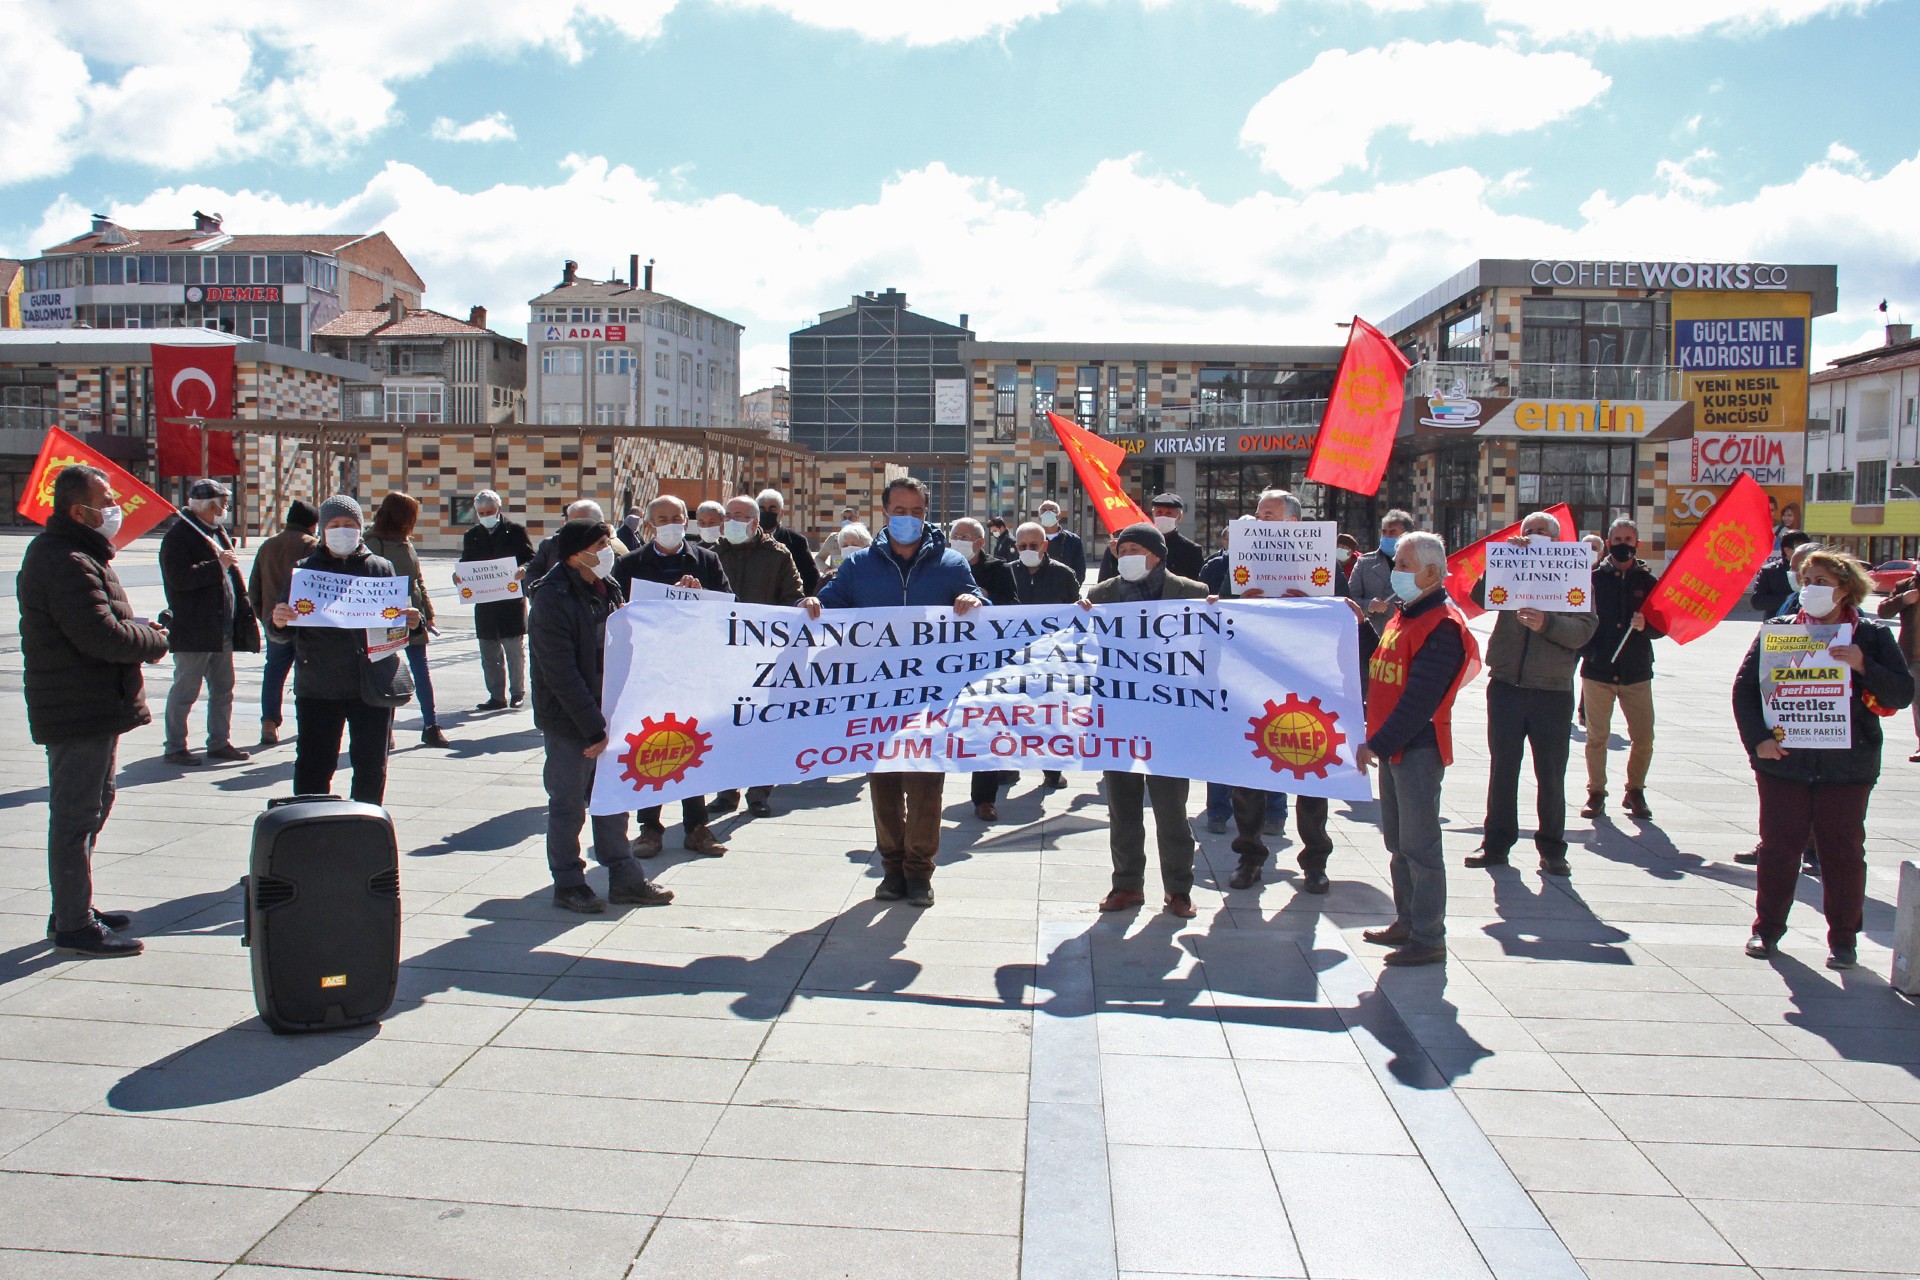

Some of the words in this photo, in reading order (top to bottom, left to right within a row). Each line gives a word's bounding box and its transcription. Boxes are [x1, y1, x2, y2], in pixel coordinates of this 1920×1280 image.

[30, 293, 61, 307] GURUR
[206, 287, 280, 302] DEMER
[23, 308, 72, 323] TABLOMUZ
[568, 328, 602, 339] ADA
[1692, 320, 1784, 345] GÜÇLENEN
[1679, 346, 1764, 367] KADROSU
[1703, 393, 1773, 408] KURSUN
[1515, 400, 1645, 433] emin
[1704, 406, 1769, 425] ÖNCÜSÜ
[1154, 434, 1226, 453] KIRTASİYE
[1330, 428, 1376, 450] EMEK
[1701, 434, 1785, 466] ÇÖZÜM
[1243, 527, 1291, 538] ZAMLAR
[1293, 526, 1322, 538] GERİ
[1251, 541, 1295, 550] ALINSIN
[1299, 541, 1313, 550] VE
[1491, 545, 1587, 557] ZENGİNLERDEN
[1717, 535, 1745, 557] EMEP
[1238, 552, 1321, 562] DONDURULSUN
[1489, 559, 1536, 569] SERVET
[1540, 558, 1588, 570] VERGİSİ
[308, 574, 353, 586] ASGARİ
[357, 579, 396, 588] ÜCRET
[1512, 572, 1561, 582] ALINSIN
[302, 581, 364, 595] VERGİDEN
[1680, 571, 1723, 604] EMEK
[316, 591, 378, 604] TUTULSUN
[1536, 593, 1562, 601] PARTİSİ
[1663, 586, 1717, 625] PARTİSİ
[726, 611, 901, 647] İNSANCA
[911, 614, 978, 645] BİR
[988, 614, 1126, 640] YAŞAM
[1136, 606, 1236, 644] İÇİN;
[1766, 633, 1809, 643] insanca
[1766, 643, 1778, 651] bir
[752, 658, 923, 689] ZAMLAR
[936, 642, 1033, 674] GERİ
[1045, 642, 1208, 677] ALINSIN
[1775, 668, 1839, 681] ZAMLAR
[1781, 685, 1803, 696] geri
[732, 685, 945, 727] ÜCRETLER
[953, 672, 1228, 712] ARTTIRILSIN!
[1771, 699, 1836, 711] ücretler
[846, 708, 950, 738] EMEK
[962, 700, 1105, 729] PARTİSİ
[1778, 712, 1846, 722] arttırılsın
[1788, 728, 1812, 736] EMEK
[1814, 726, 1846, 736] PARTİSİ
[1268, 731, 1326, 751] EMEP
[640, 745, 694, 765] EMEP
[795, 736, 932, 774] ÇORUM
[945, 732, 977, 761] İL
[990, 732, 1153, 762] ÖRGÜTÜ
